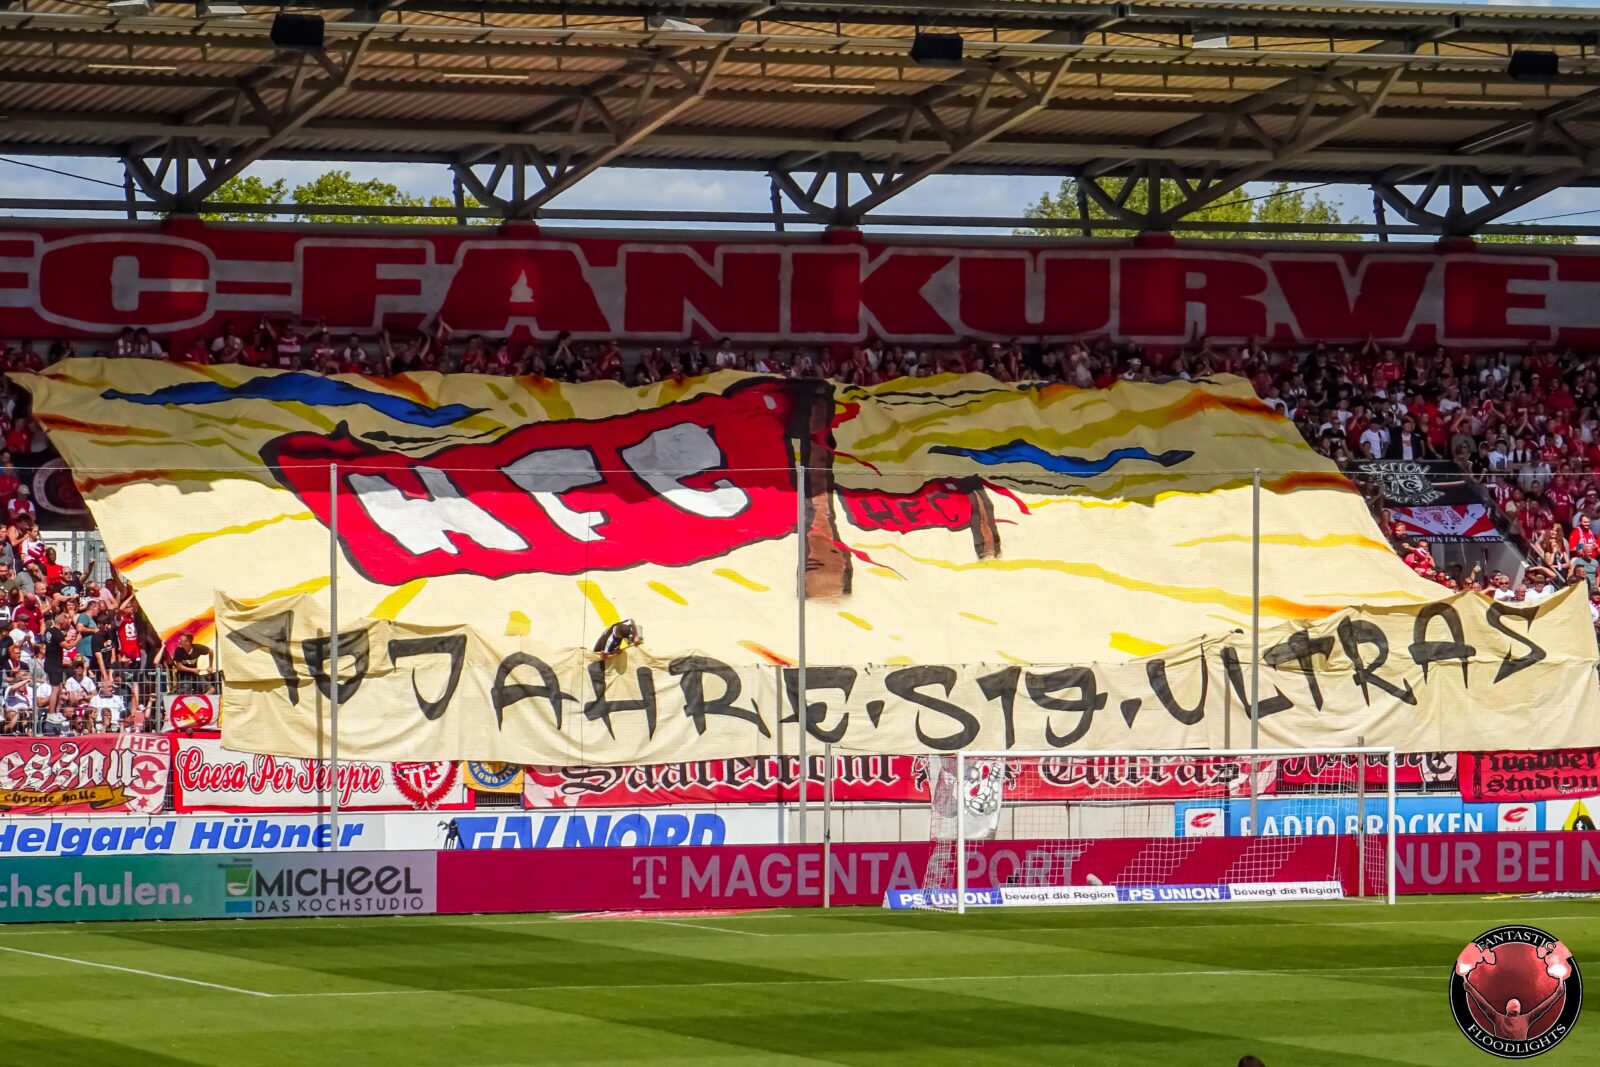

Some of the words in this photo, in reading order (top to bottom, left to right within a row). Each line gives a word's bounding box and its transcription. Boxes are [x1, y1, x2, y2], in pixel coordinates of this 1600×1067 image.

[1358, 462, 1431, 474] SEKTION
[343, 421, 753, 556] HFC
[859, 490, 960, 526] HFC
[130, 736, 169, 753] HFC
[177, 747, 248, 792] Coesa
[249, 754, 296, 794] Per
[297, 758, 384, 806] Sempre
[190, 817, 364, 850] Hübner
[1496, 840, 1564, 883] BEI
[681, 852, 917, 898] MAGENTA
[930, 849, 1081, 888] SPORT
[900, 893, 927, 905] PS
[1004, 889, 1049, 902] bewegt
[1052, 889, 1071, 899] die
[1073, 889, 1115, 900] Region
[1129, 889, 1155, 901] PS
[1159, 887, 1220, 900] UNION
[1233, 887, 1278, 898] bewegt
[1281, 886, 1298, 895] die
[1299, 885, 1341, 896] Region
[255, 899, 290, 913] DAS
[298, 896, 424, 912] KOCHSTUDIO
